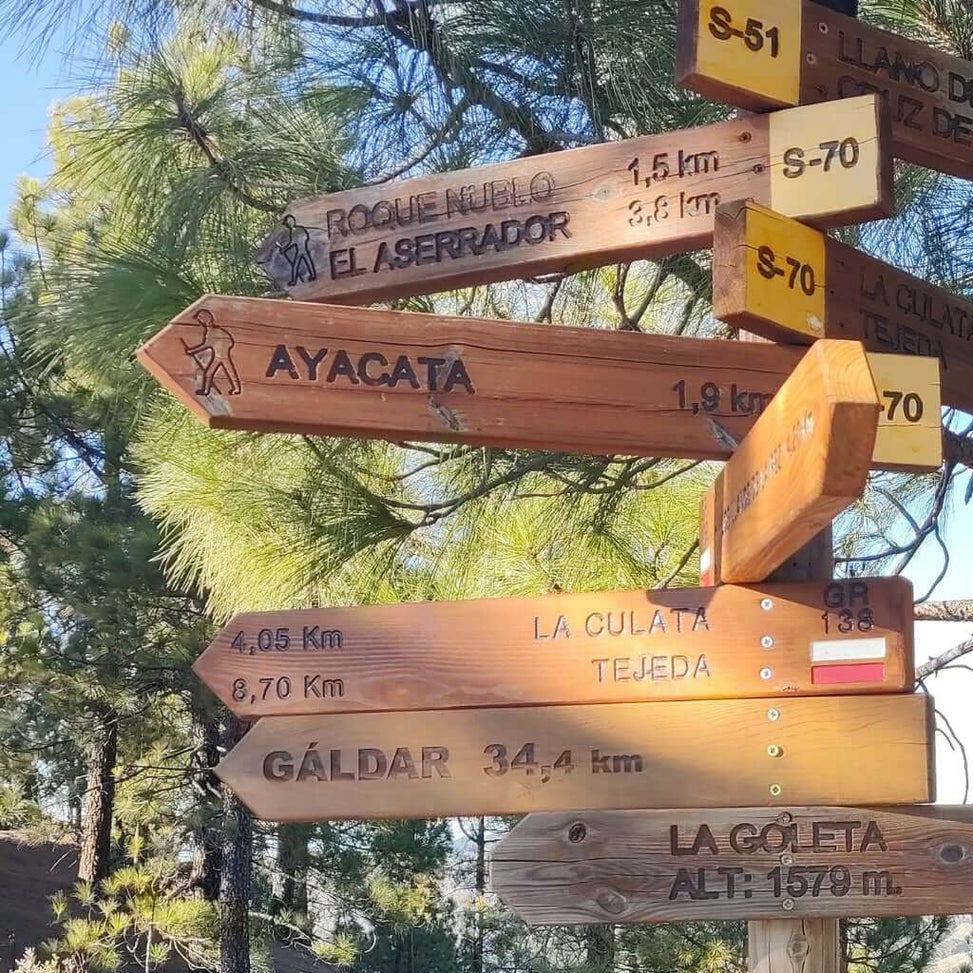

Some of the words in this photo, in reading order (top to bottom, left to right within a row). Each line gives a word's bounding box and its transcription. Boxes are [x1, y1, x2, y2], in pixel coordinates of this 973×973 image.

[708, 5, 780, 59] S-51
[837, 31, 940, 93] LLANO
[932, 106, 973, 147] DE
[782, 136, 860, 179] S-70
[326, 190, 437, 241] ROQUE
[446, 171, 556, 220] NUBLO
[628, 152, 670, 188] 1,5
[678, 148, 720, 179] km
[329, 247, 368, 280] EL
[372, 211, 573, 274] ASERRADOR
[628, 194, 669, 227] 3,8
[680, 191, 720, 220] km
[756, 245, 816, 297] S-70
[859, 268, 890, 307] LA
[859, 309, 948, 370] TEJEDA
[265, 343, 478, 396] AYACATA
[672, 379, 721, 417] 1,9
[730, 384, 775, 413] km
[880, 390, 924, 423] -70
[824, 578, 870, 610] GR
[230, 628, 292, 656] 4,05
[302, 626, 344, 652] Km
[534, 614, 571, 642] LA
[576, 606, 711, 640] CULATA
[820, 607, 874, 636] 138
[231, 676, 292, 704] 8,70
[303, 674, 345, 700] Km
[591, 654, 712, 686] TEJEDA
[262, 740, 452, 785] GÁLDAR
[482, 742, 574, 785] 34,4
[591, 748, 644, 776] km
[668, 823, 724, 858] LA
[728, 819, 889, 856] GOLETA
[668, 868, 754, 902] ALT:
[764, 864, 848, 899] 1579
[860, 870, 904, 898] m.
